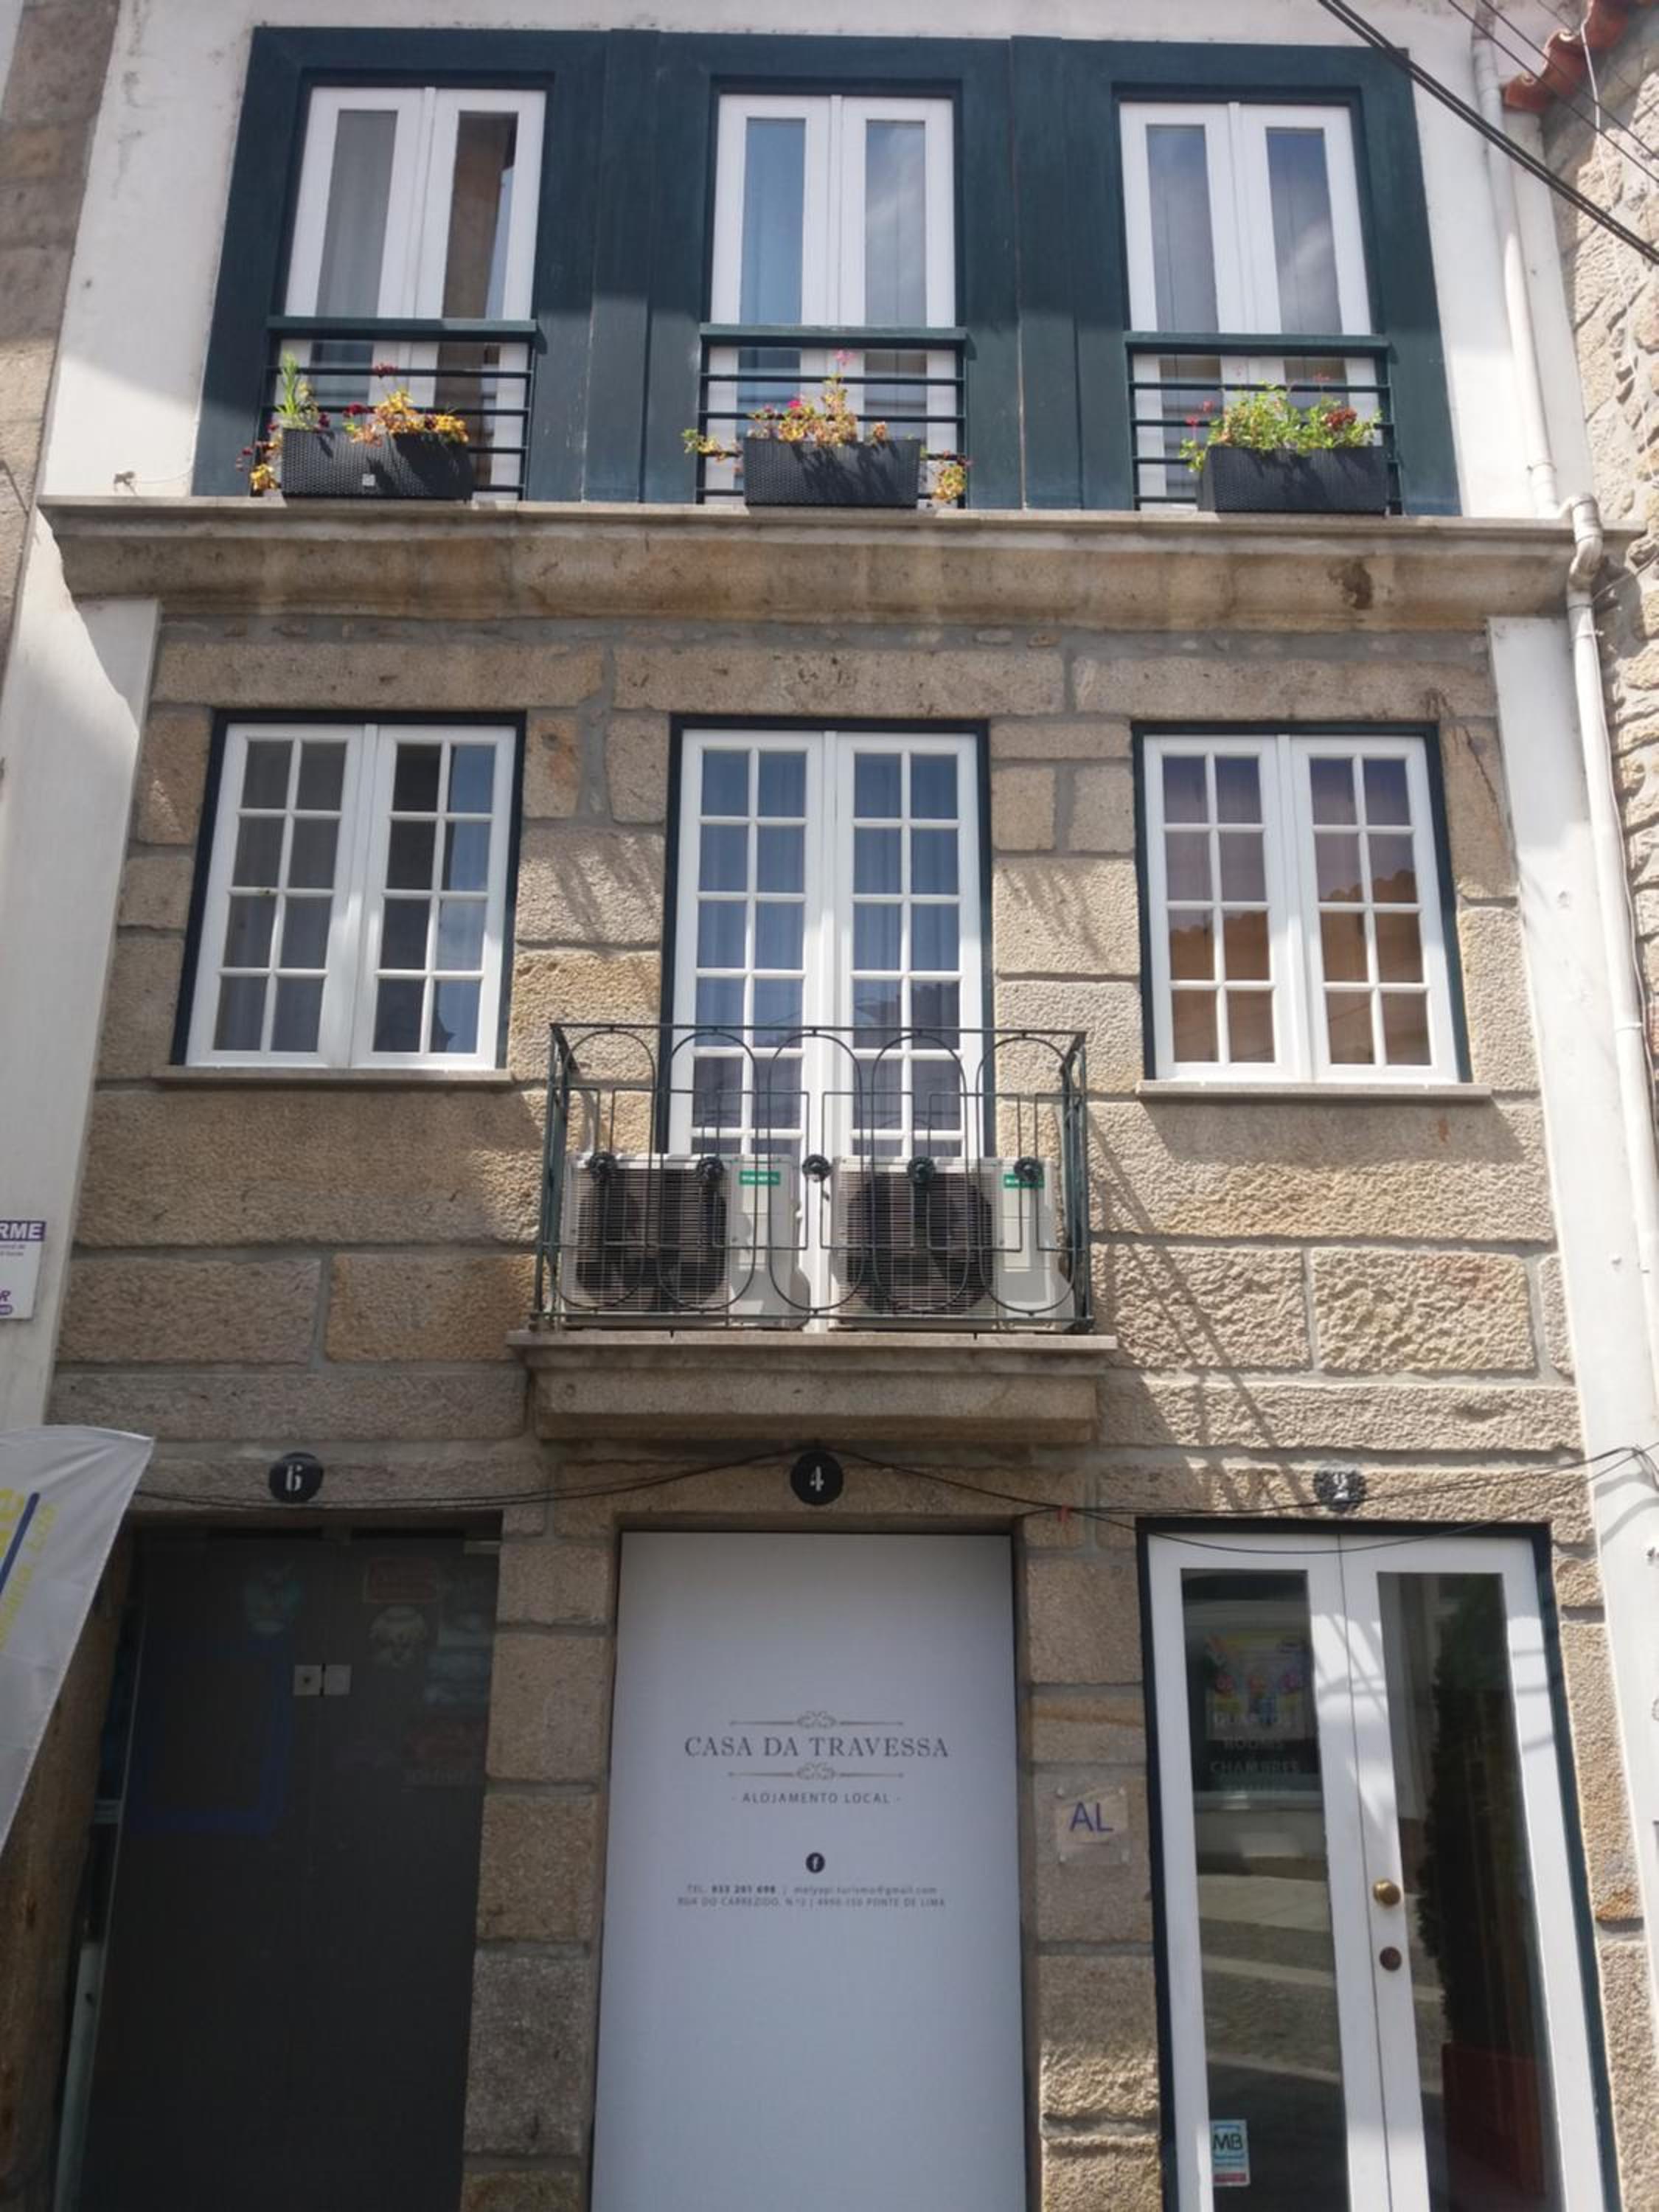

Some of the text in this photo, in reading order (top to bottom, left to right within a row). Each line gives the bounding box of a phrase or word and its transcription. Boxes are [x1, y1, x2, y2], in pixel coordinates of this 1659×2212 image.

[285, 1464, 304, 1492] 6
[809, 1465, 825, 1492] 4
[1332, 1473, 1350, 1500] 2
[684, 1736, 950, 1757] CASA DA TRAVESSA
[742, 1792, 890, 1804] ALOJAMENTO LOCAL
[1069, 1801, 1114, 1832] AL
[1213, 2133, 1243, 2150] MB
